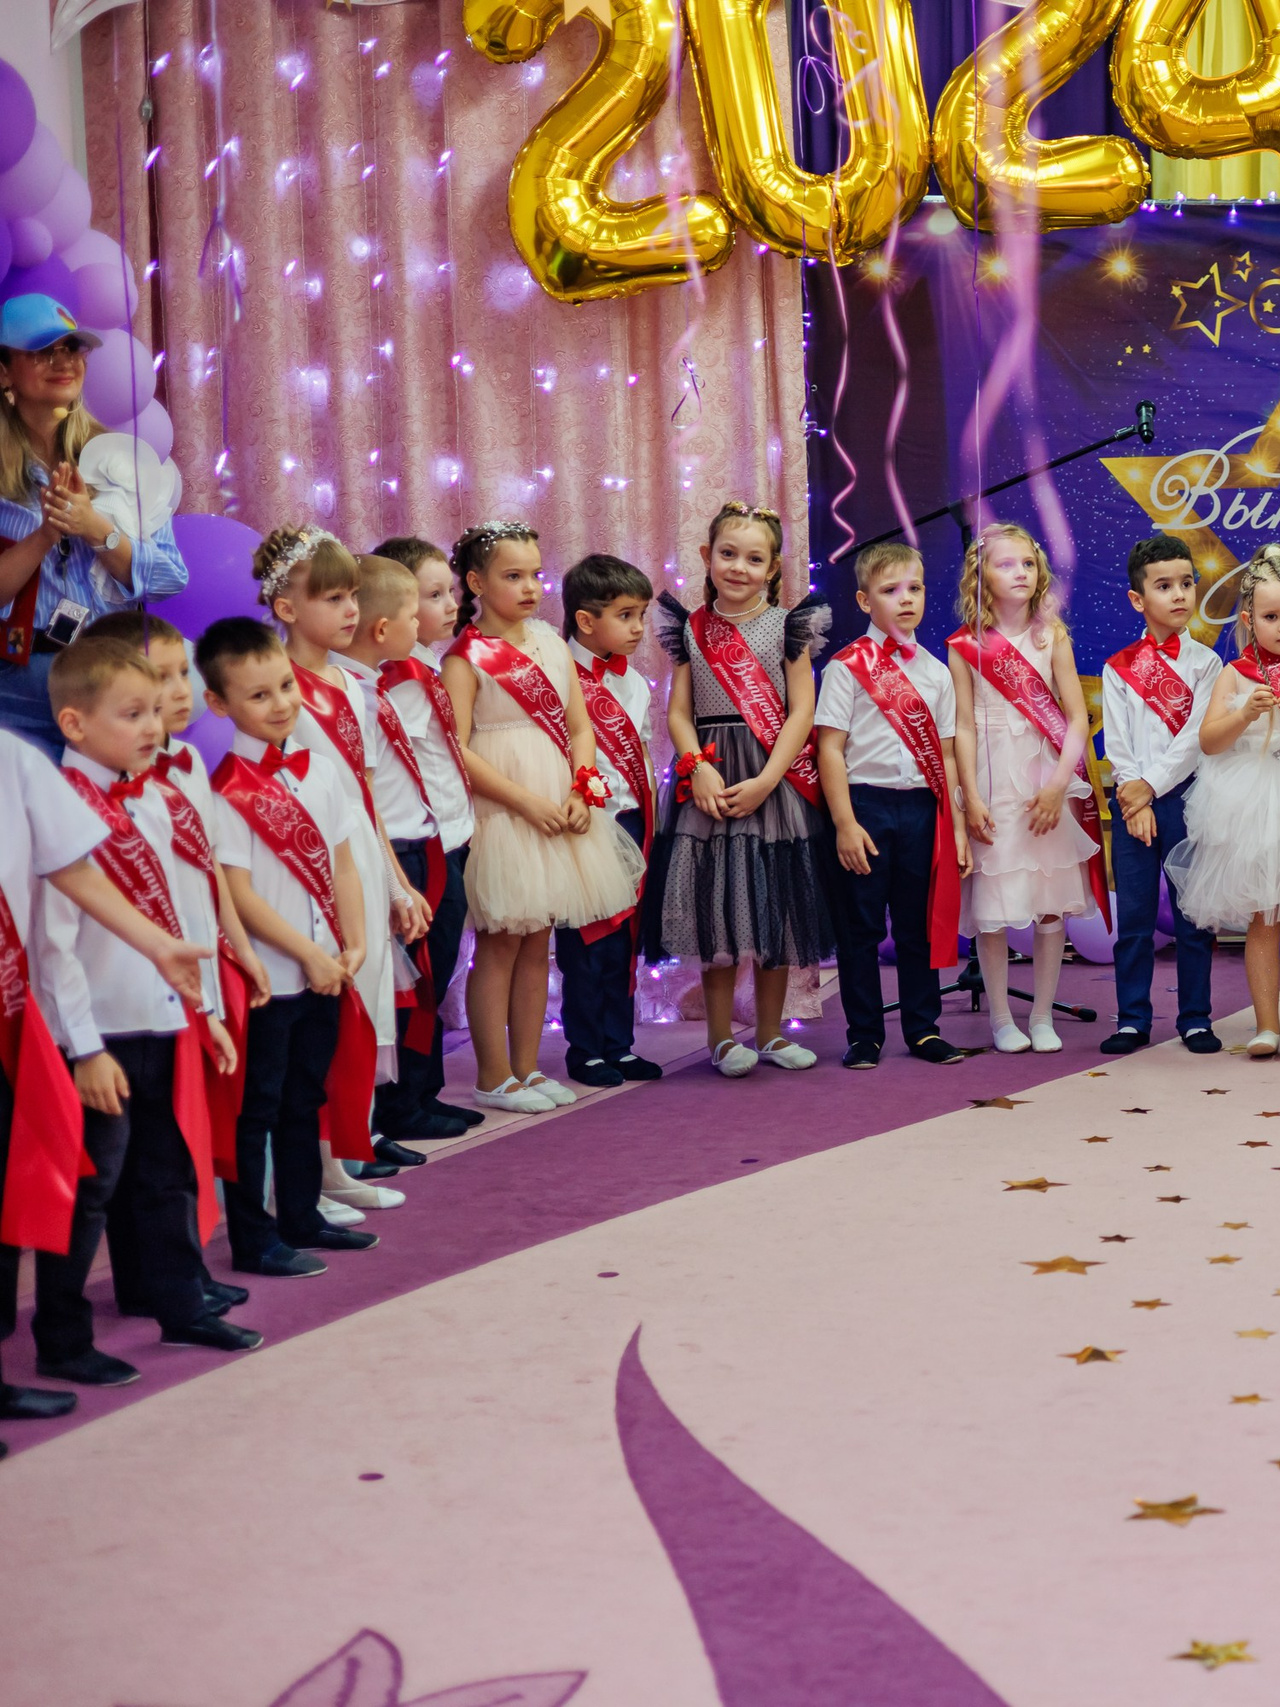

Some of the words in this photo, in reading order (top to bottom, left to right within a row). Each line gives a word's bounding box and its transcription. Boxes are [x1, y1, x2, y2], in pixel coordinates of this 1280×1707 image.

[712, 662, 742, 698] детского
[741, 700, 756, 720] сада
[756, 721, 775, 745] №4
[723, 642, 783, 734] Выпускни
[532, 710, 565, 747] детского
[1013, 697, 1049, 731] детского
[1146, 696, 1180, 730] детского
[593, 696, 645, 789] Выпускни
[884, 709, 916, 746] детского
[915, 747, 927, 767] сада
[613, 752, 629, 772] сада
[132, 888, 154, 916] сада
[279, 849, 322, 893] детского
[320, 894, 334, 918] сада
